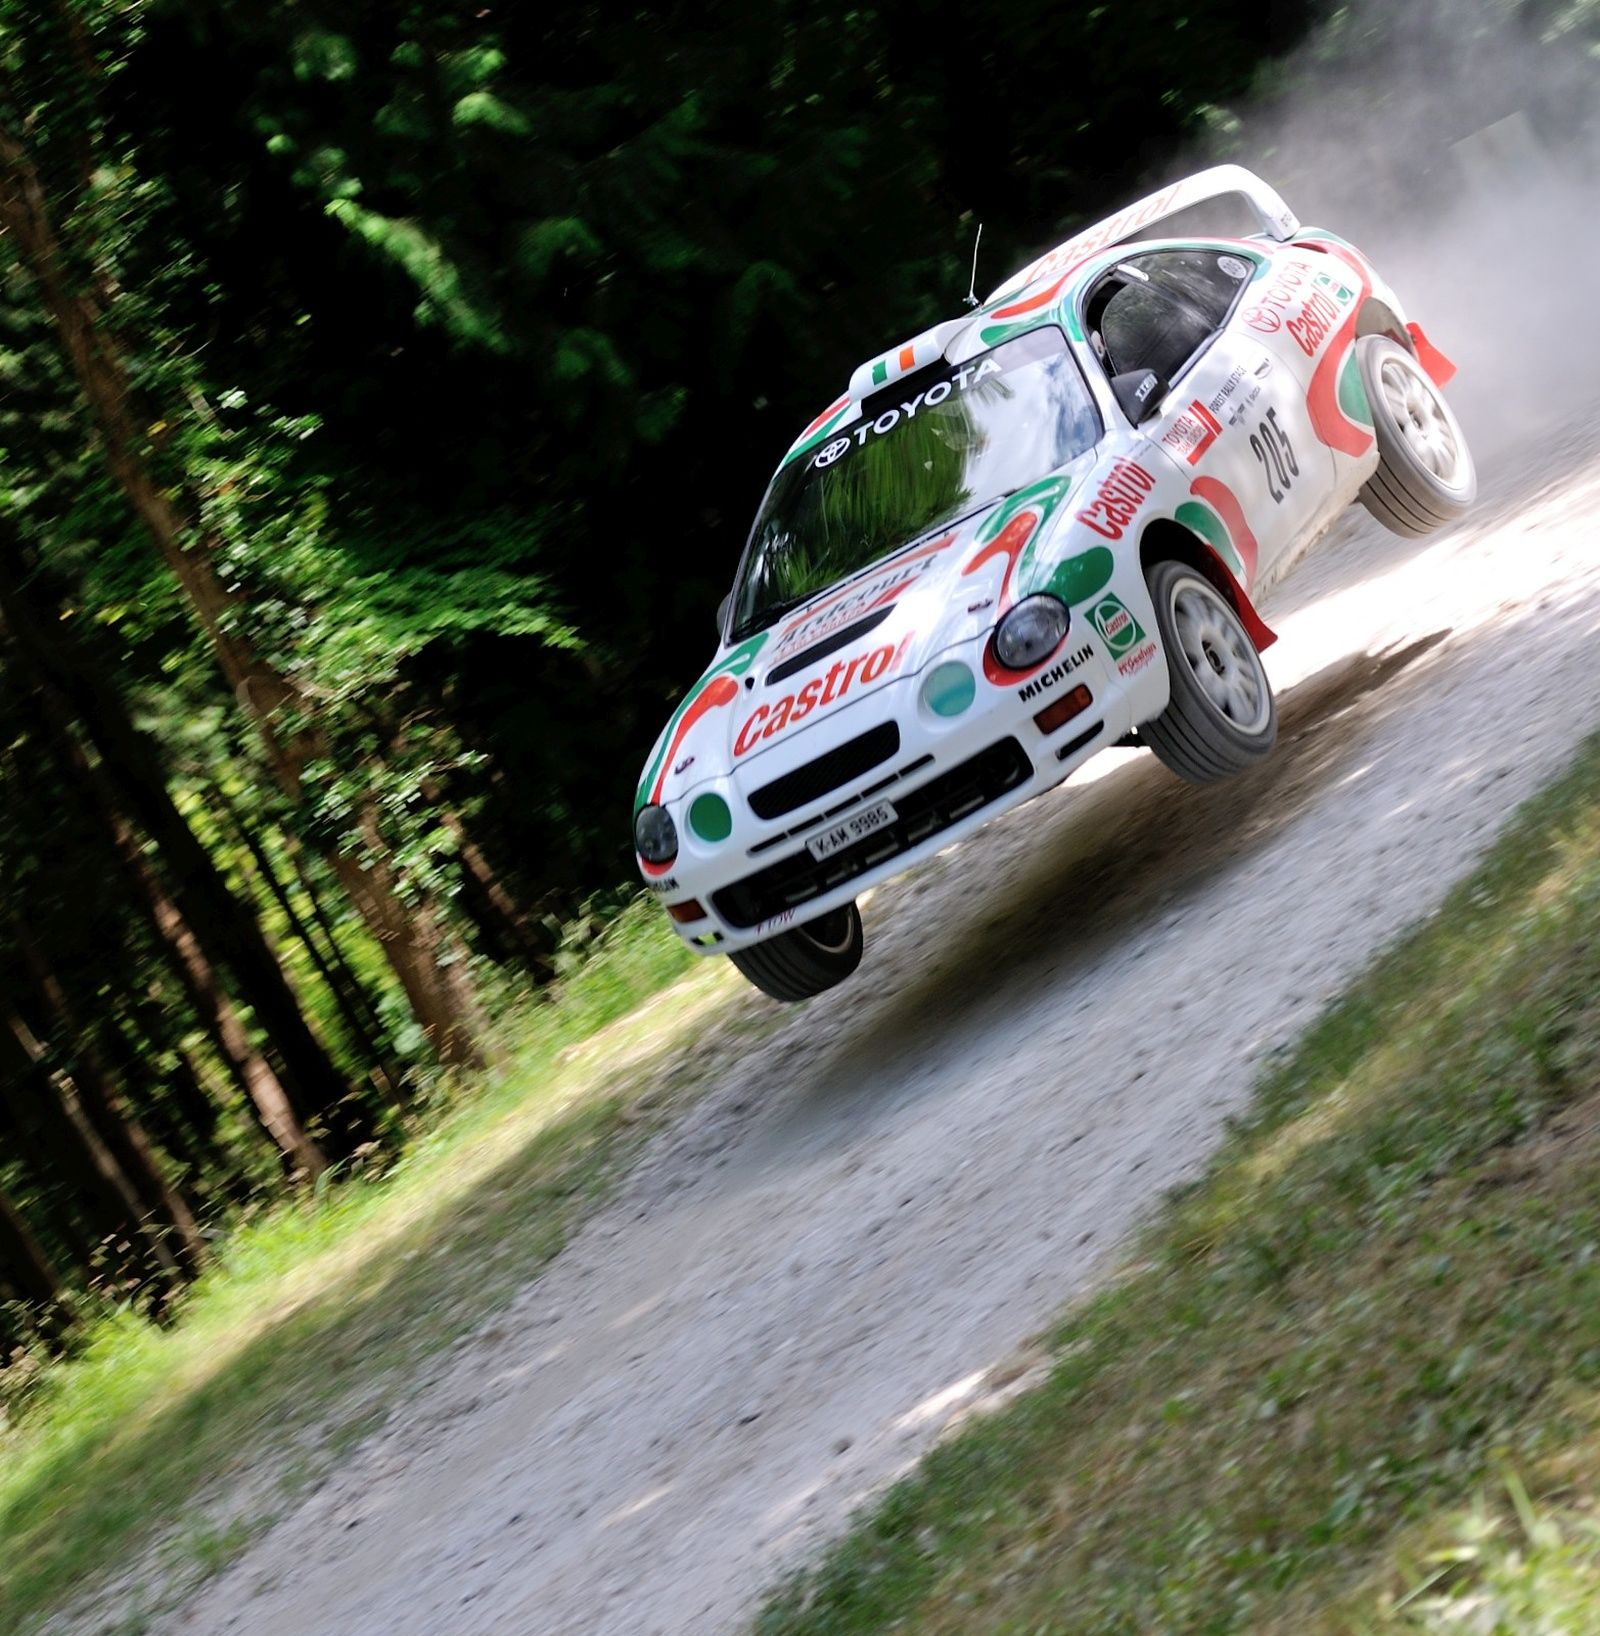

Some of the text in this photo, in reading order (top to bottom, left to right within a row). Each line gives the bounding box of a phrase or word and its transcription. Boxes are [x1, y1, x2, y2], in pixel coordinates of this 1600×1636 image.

[1025, 183, 1183, 286] Castrol
[1261, 261, 1312, 309] TOYOTA
[1286, 283, 1341, 357] Castrol
[854, 358, 1002, 446] TOYOTA
[1162, 415, 1196, 446] TOYOTA
[1209, 393, 1225, 414] FOREST
[1221, 380, 1237, 399] RALLY
[1250, 407, 1299, 504] 205
[1076, 456, 1156, 540] Castrol
[1105, 611, 1129, 636] Castrol
[734, 630, 916, 757] Castrol
[1018, 643, 1095, 702] MICHELIN
